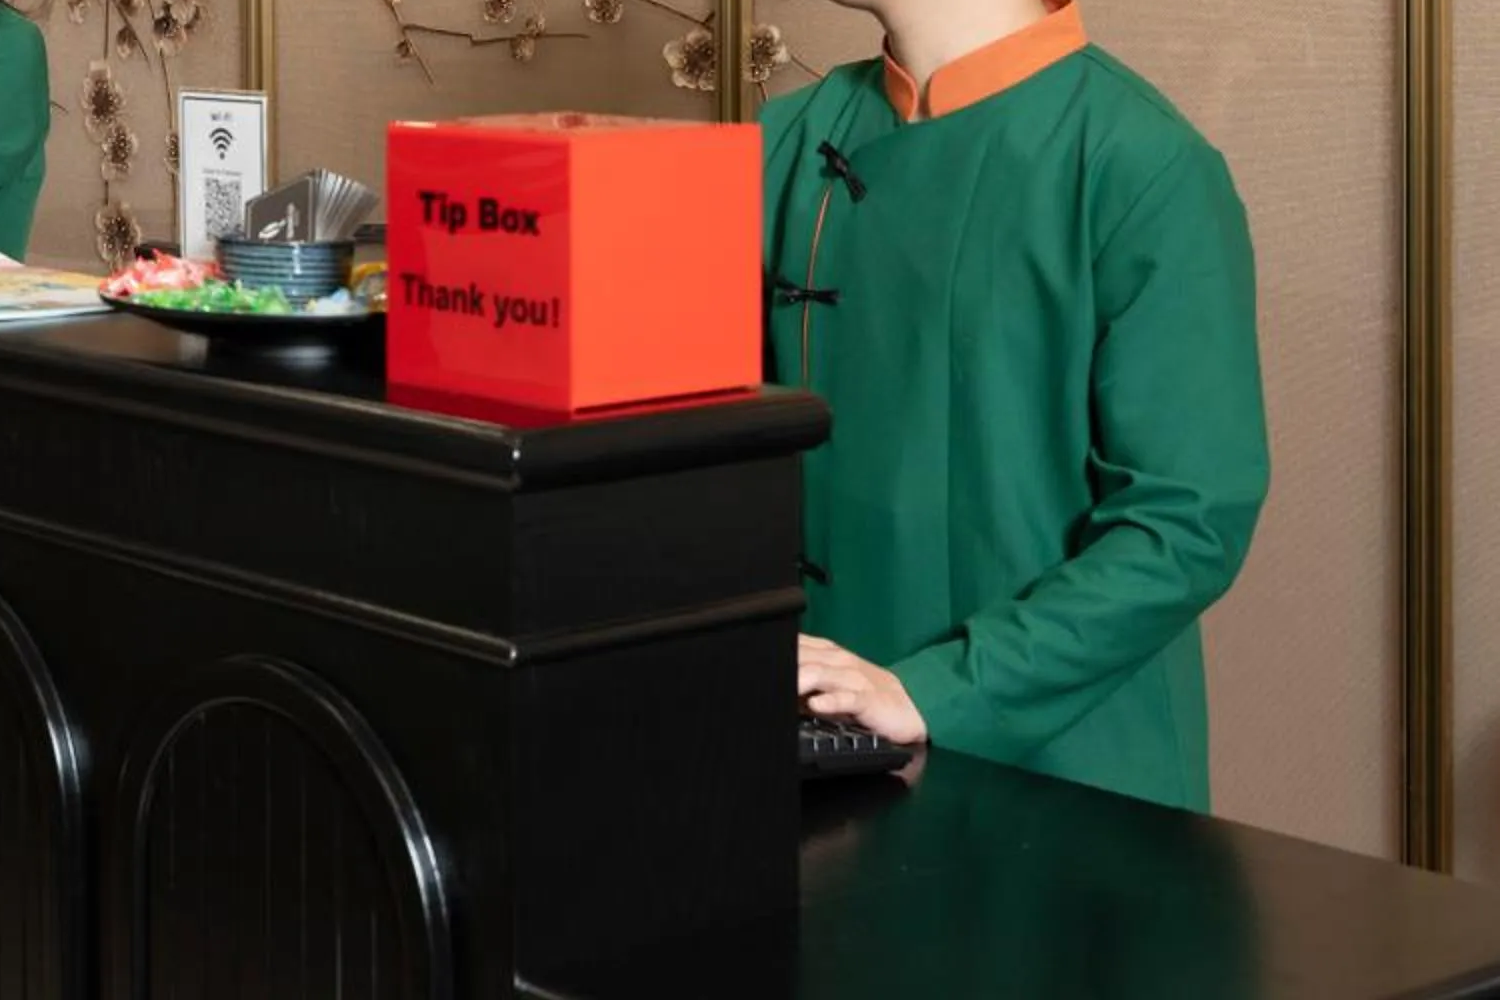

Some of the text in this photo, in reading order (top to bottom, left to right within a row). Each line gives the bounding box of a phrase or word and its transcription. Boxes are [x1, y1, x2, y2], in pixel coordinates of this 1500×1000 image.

[418, 191, 540, 236] Tip Box
[401, 273, 561, 329] Thank you!
